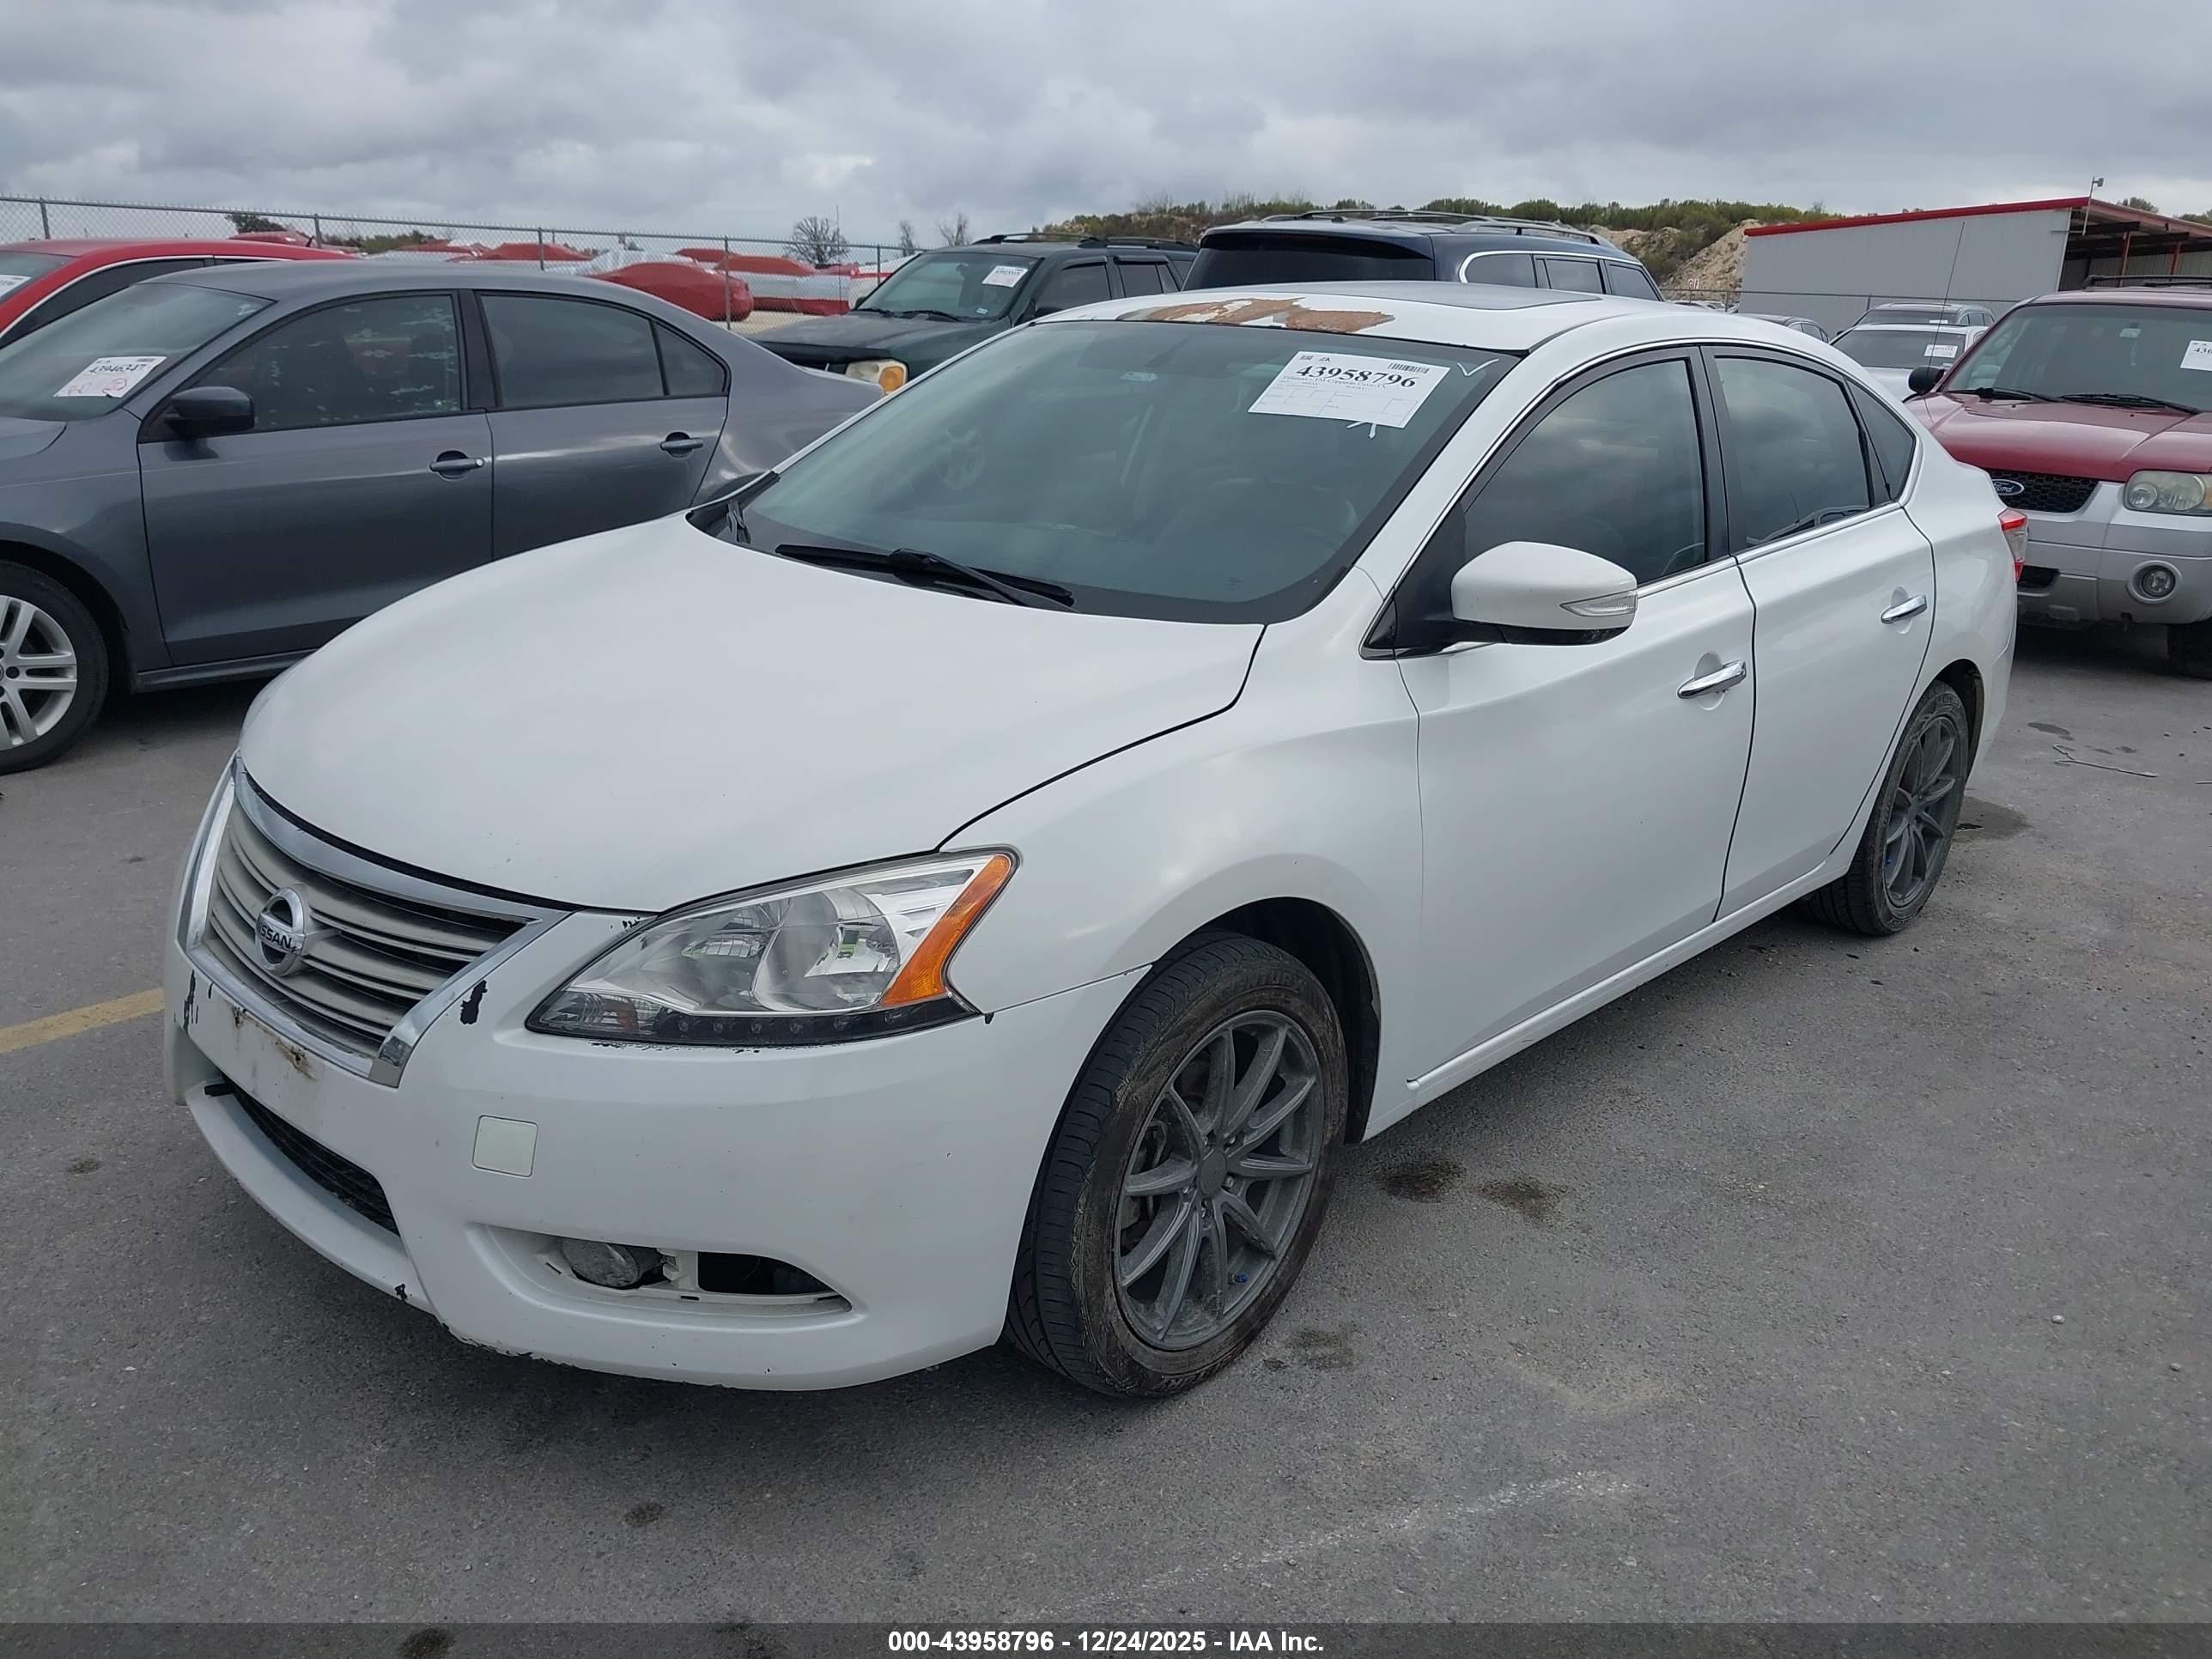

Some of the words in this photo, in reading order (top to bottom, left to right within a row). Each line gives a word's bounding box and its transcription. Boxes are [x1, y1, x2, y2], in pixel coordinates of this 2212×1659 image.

[1296, 364, 1416, 388] 43958796
[1993, 481, 2015, 493] Ford
[259, 924, 293, 949] SSAN
